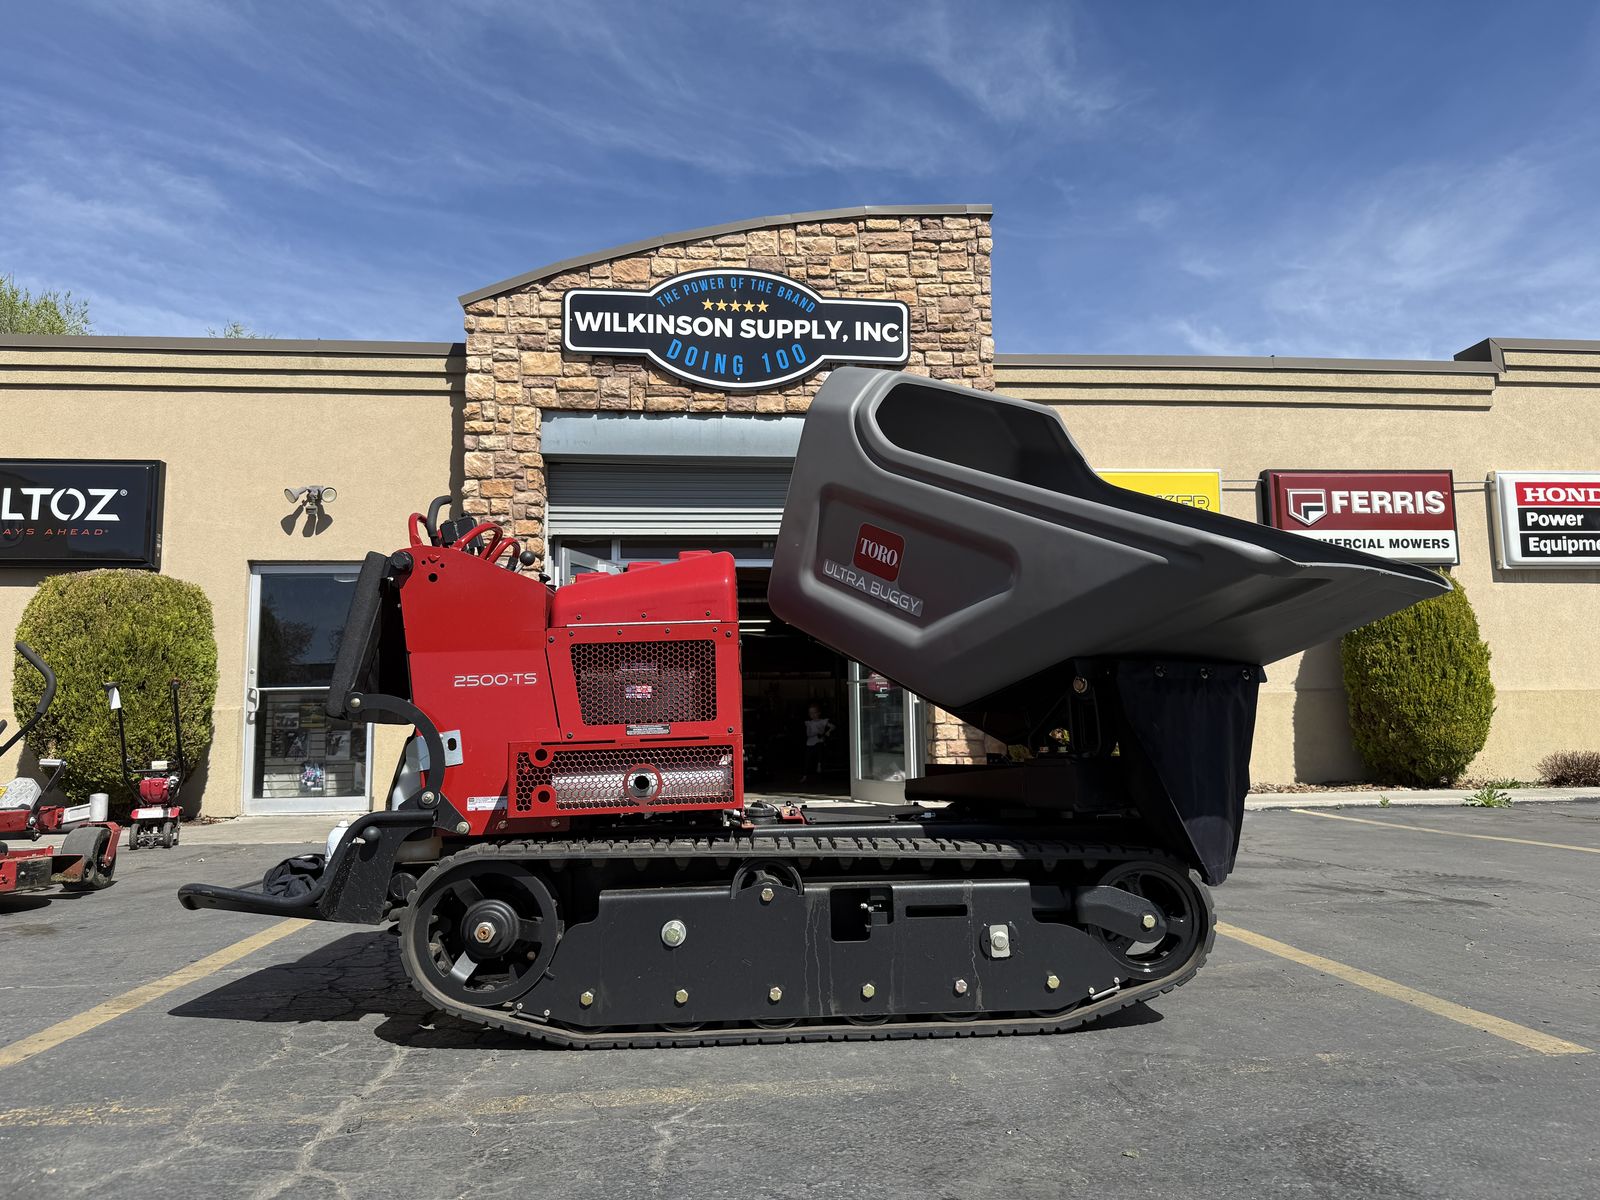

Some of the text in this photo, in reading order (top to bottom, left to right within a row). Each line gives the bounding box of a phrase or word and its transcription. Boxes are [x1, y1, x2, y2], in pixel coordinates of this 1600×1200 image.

[656, 277, 816, 313] THE POWER OF THE BRAND
[573, 310, 900, 343] WILKINSON SUPPLY, INC
[666, 338, 807, 376] DOING 100
[3, 528, 35, 536] AYS
[1526, 511, 1584, 527] Power
[860, 537, 898, 567] TORO
[1389, 538, 1450, 549] MOWERS
[824, 560, 920, 612] ULTRA BUGGY
